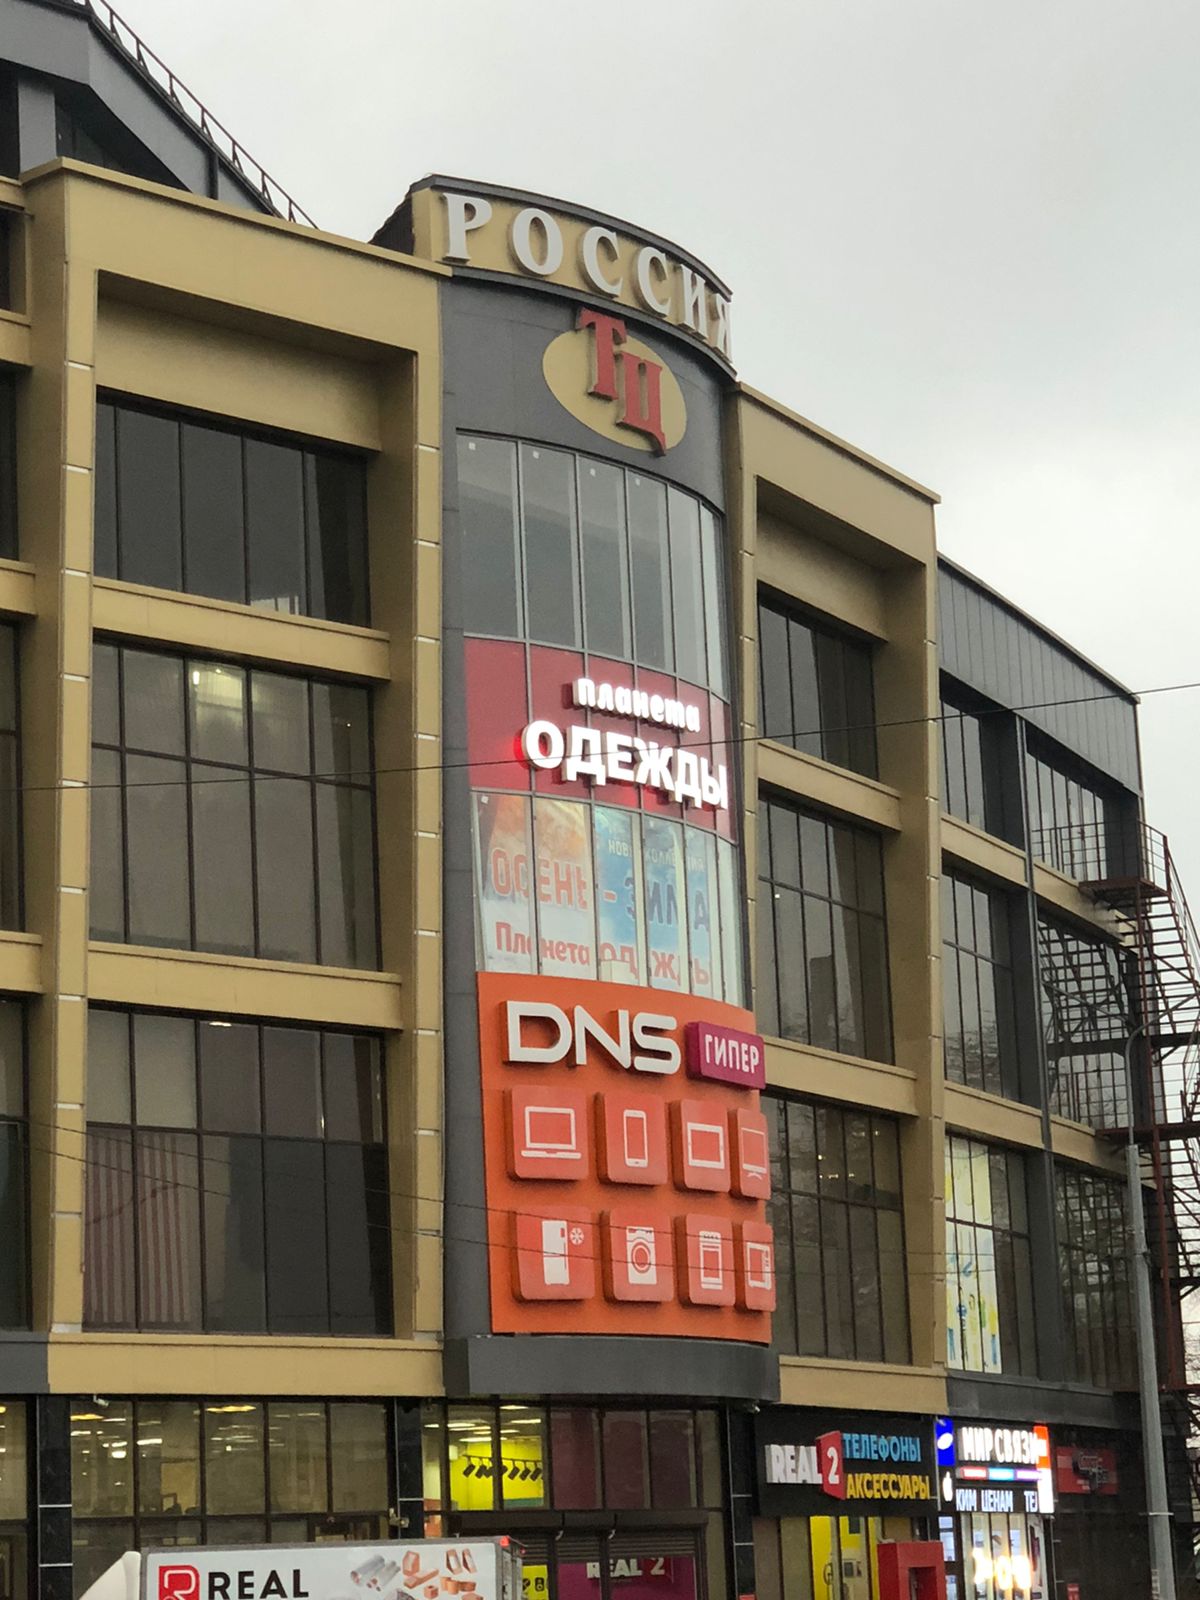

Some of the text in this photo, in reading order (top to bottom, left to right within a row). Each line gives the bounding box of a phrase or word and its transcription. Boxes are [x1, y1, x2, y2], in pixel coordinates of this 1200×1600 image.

[442, 192, 732, 363] РОССИЯ
[579, 306, 666, 455] ТЦ
[522, 719, 729, 810] ОДЕЖДЫ
[492, 848, 588, 910] ОСЕНЬ
[496, 921, 592, 966] Планета
[506, 1000, 682, 1075] DNS
[704, 1033, 760, 1075] ГИПЕР
[769, 1443, 840, 1485] REAL 2
[842, 1432, 922, 1463] ТЕЛЕФОНЫ
[961, 1427, 1040, 1465] МИР СВЯЗИ
[846, 1473, 931, 1500] АКСЕССУАРЫ
[208, 1569, 309, 1600] REAL
